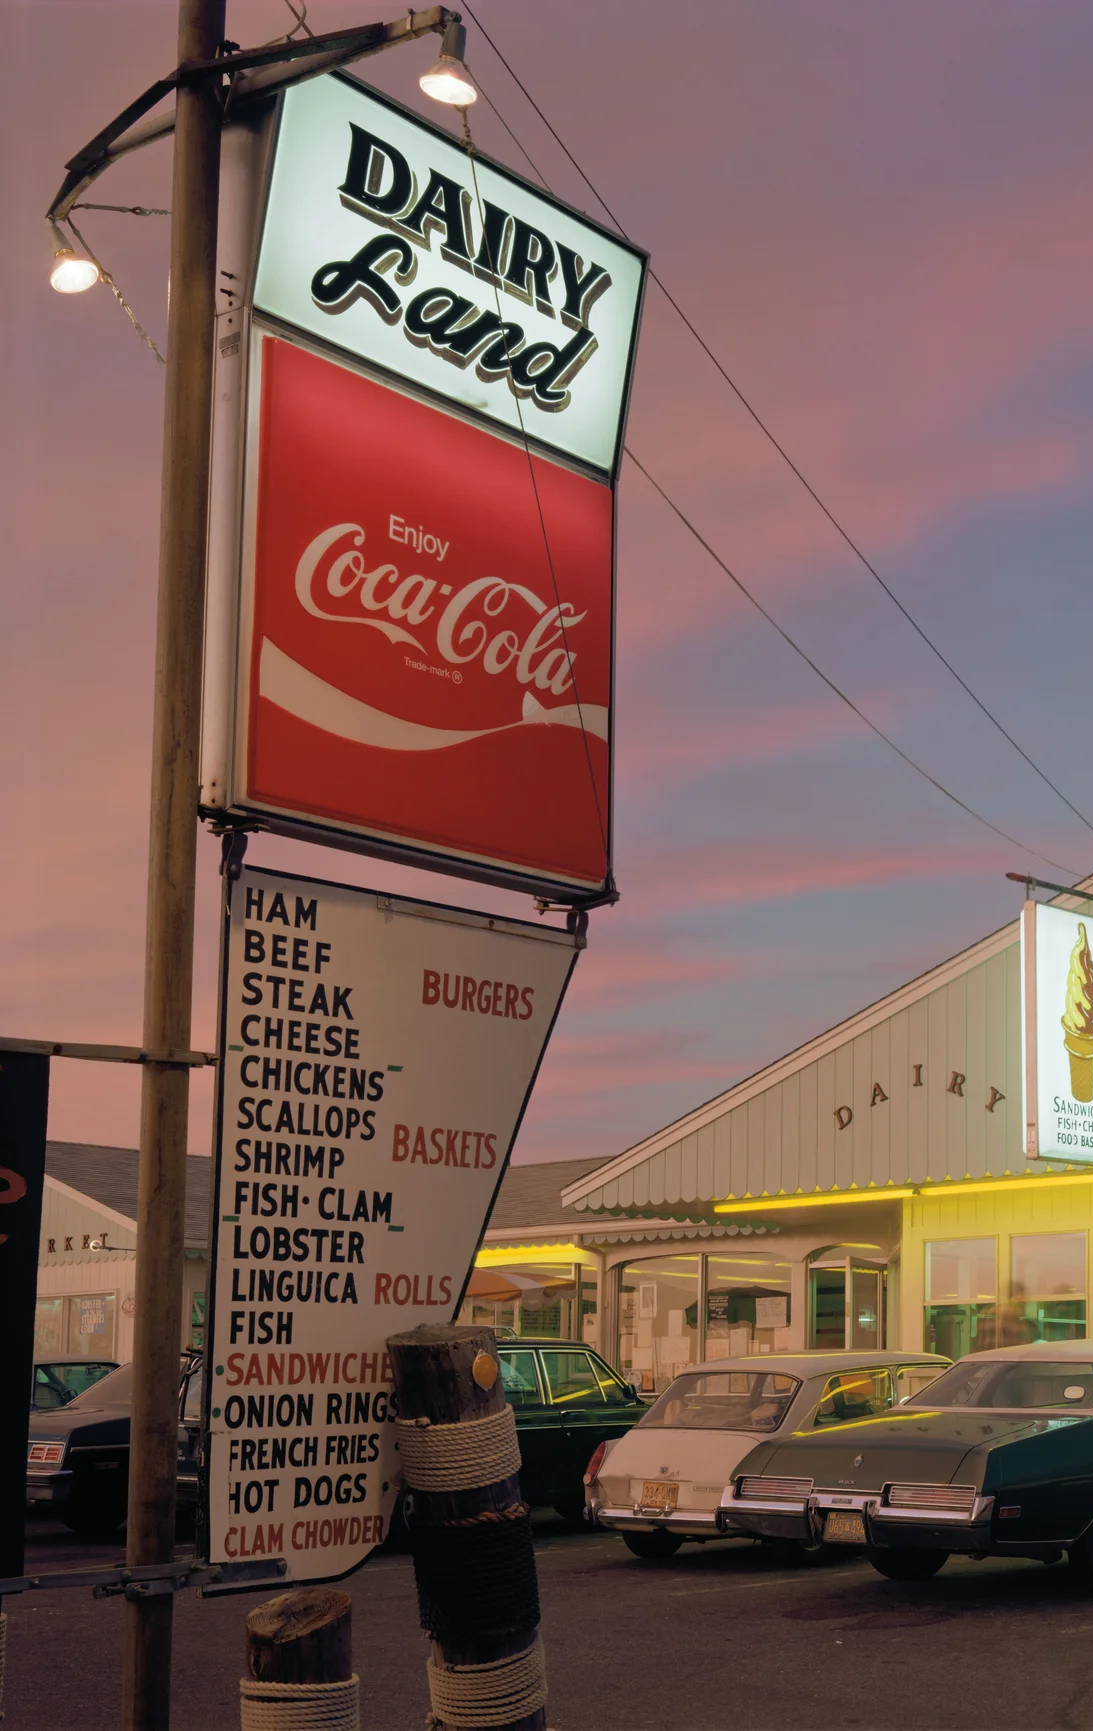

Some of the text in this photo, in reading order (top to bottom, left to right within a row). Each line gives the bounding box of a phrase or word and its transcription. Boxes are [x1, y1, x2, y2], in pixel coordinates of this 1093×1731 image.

[337, 121, 612, 330] DAIRY
[311, 233, 599, 413] Land
[389, 514, 449, 561] Enjoy
[403, 656, 451, 679] Trade-mark
[245, 887, 319, 931] HAM
[244, 928, 331, 974] BEEF
[241, 972, 354, 1020] STEAK
[421, 969, 535, 1020] BURGERS
[240, 1014, 360, 1060] CHEESE
[240, 1055, 384, 1102] CHICKENS
[832, 1063, 1006, 1131] DAIRY
[237, 1097, 377, 1141] SCALLOPS
[1057, 1132, 1079, 1146] FOOD
[234, 1138, 345, 1179] SHRIMP
[391, 1123, 498, 1170] BASKETS
[318, 1187, 393, 1224] CLAM
[47, 1233, 109, 1254] RKET
[232, 1225, 365, 1264] LOBSTER
[231, 1268, 453, 1306] LINGUICA ROLLS
[229, 1311, 294, 1345] FISH
[226, 1352, 395, 1387] SANDWICHE
[224, 1391, 399, 1429] ONION RINGS
[229, 1433, 380, 1472] FRENCH FRIES
[229, 1473, 368, 1515] HOT DOGS
[224, 1515, 385, 1558] CLAM CHOWDER
